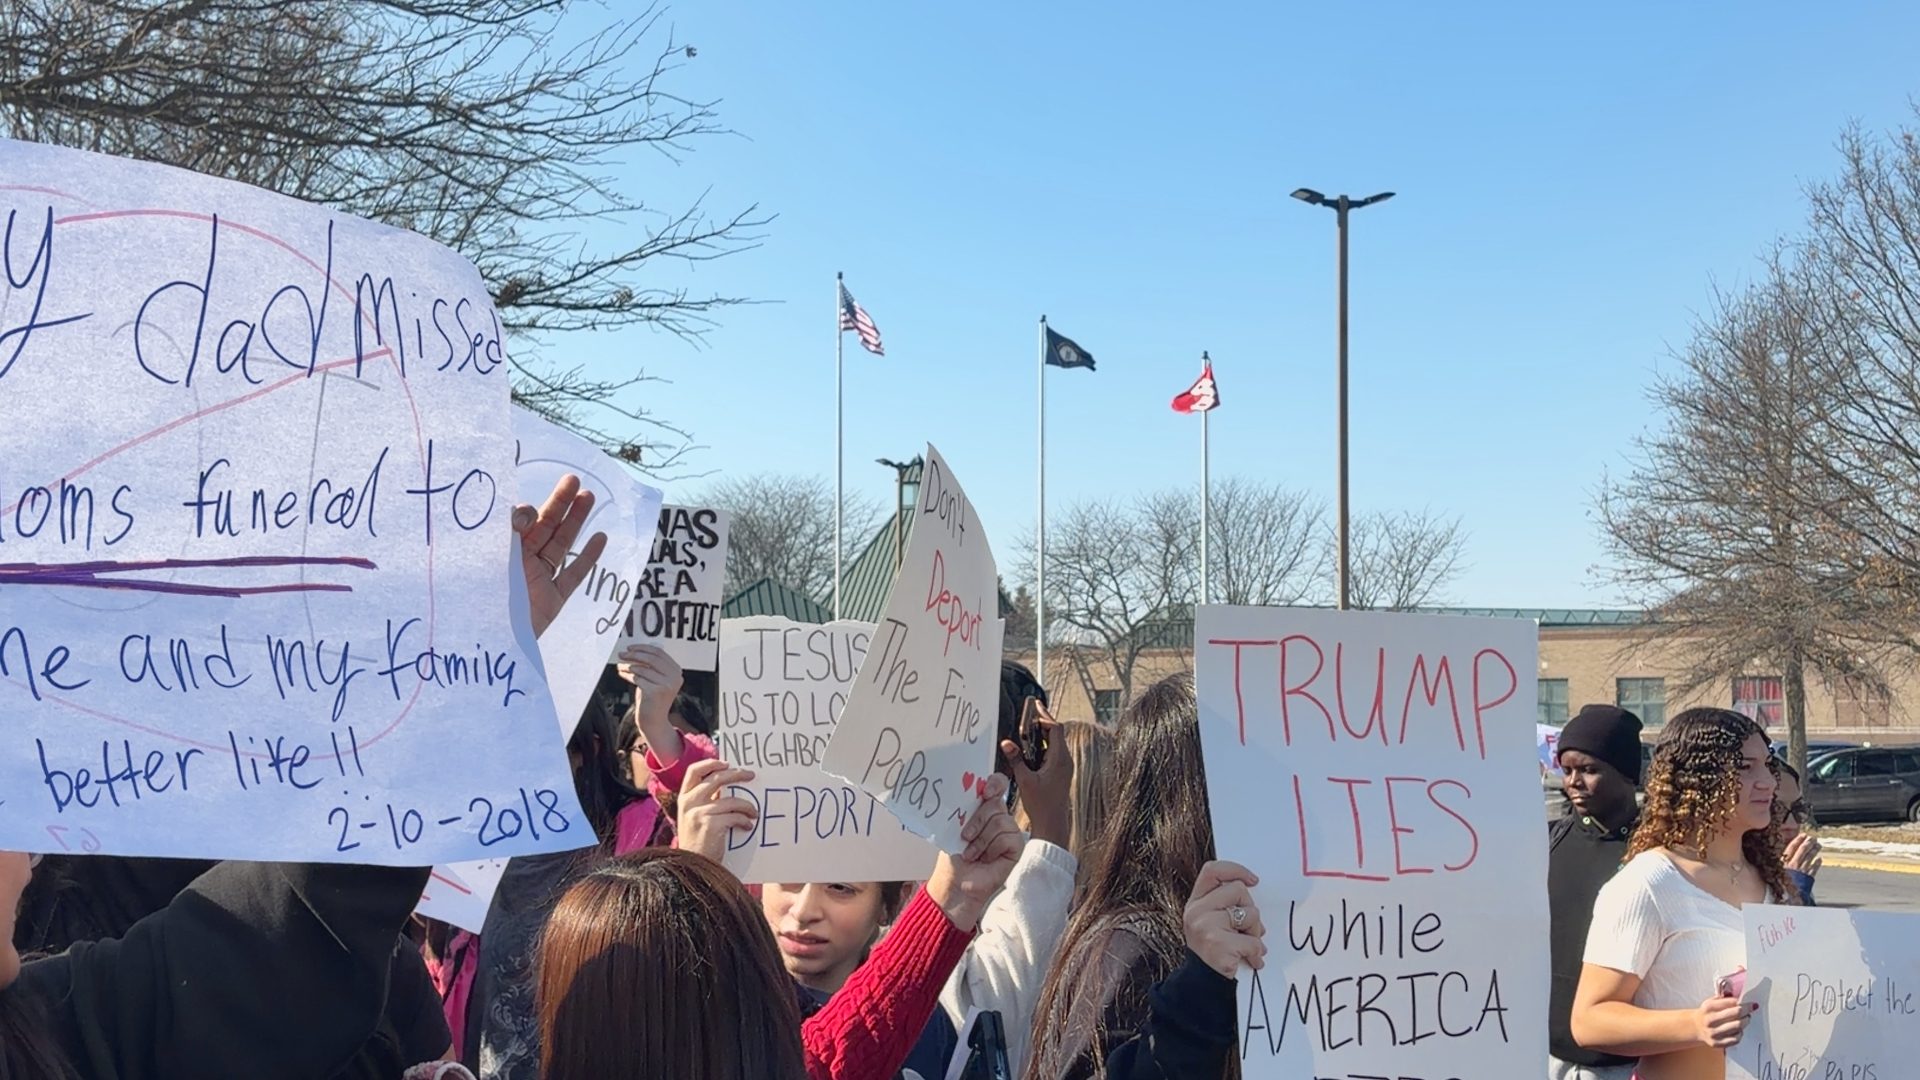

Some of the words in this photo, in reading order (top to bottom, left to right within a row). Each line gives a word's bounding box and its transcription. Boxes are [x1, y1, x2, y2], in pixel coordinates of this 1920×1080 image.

[134, 212, 333, 388] dad
[0, 478, 135, 551] oms
[405, 439, 497, 547] to
[640, 599, 720, 642] OFFICE
[673, 568, 698, 596] A
[119, 624, 252, 693] and
[266, 633, 366, 722] my
[742, 626, 870, 683] JESUS
[873, 617, 920, 705] The
[935, 667, 980, 745] Fine
[722, 690, 758, 729] US
[763, 690, 800, 727] TO
[810, 690, 850, 727] LO
[1208, 634, 1518, 760] TRUMP
[35, 737, 205, 814] better
[722, 731, 832, 769] NEIGHBO
[327, 787, 570, 852] 2-10-2018
[1293, 774, 1479, 881] LIES
[1241, 968, 1509, 1060] AMERICA
[1885, 976, 1916, 1015] the
